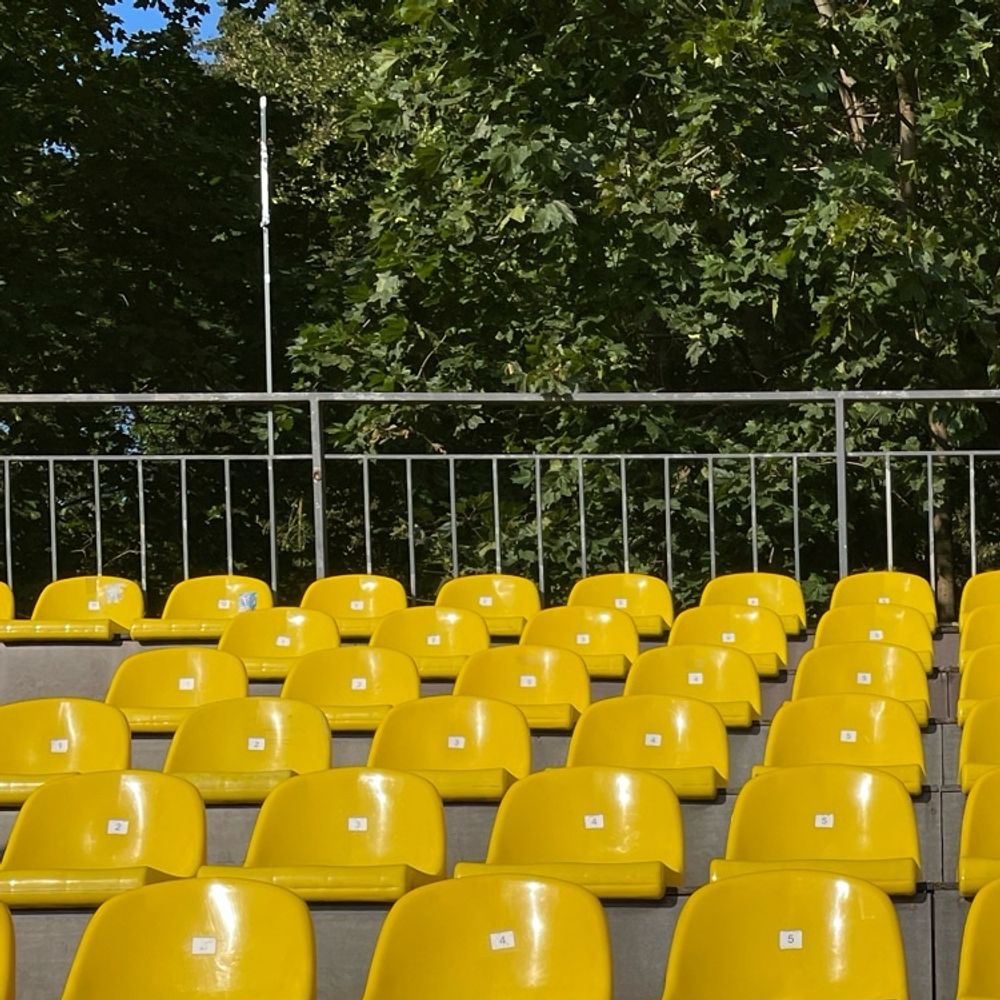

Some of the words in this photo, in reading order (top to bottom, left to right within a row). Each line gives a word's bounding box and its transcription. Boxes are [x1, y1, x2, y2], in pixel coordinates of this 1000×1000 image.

[821, 816, 828, 825] 5
[114, 822, 122, 831] 2
[499, 935, 506, 944] 4
[787, 934, 795, 944] 5
